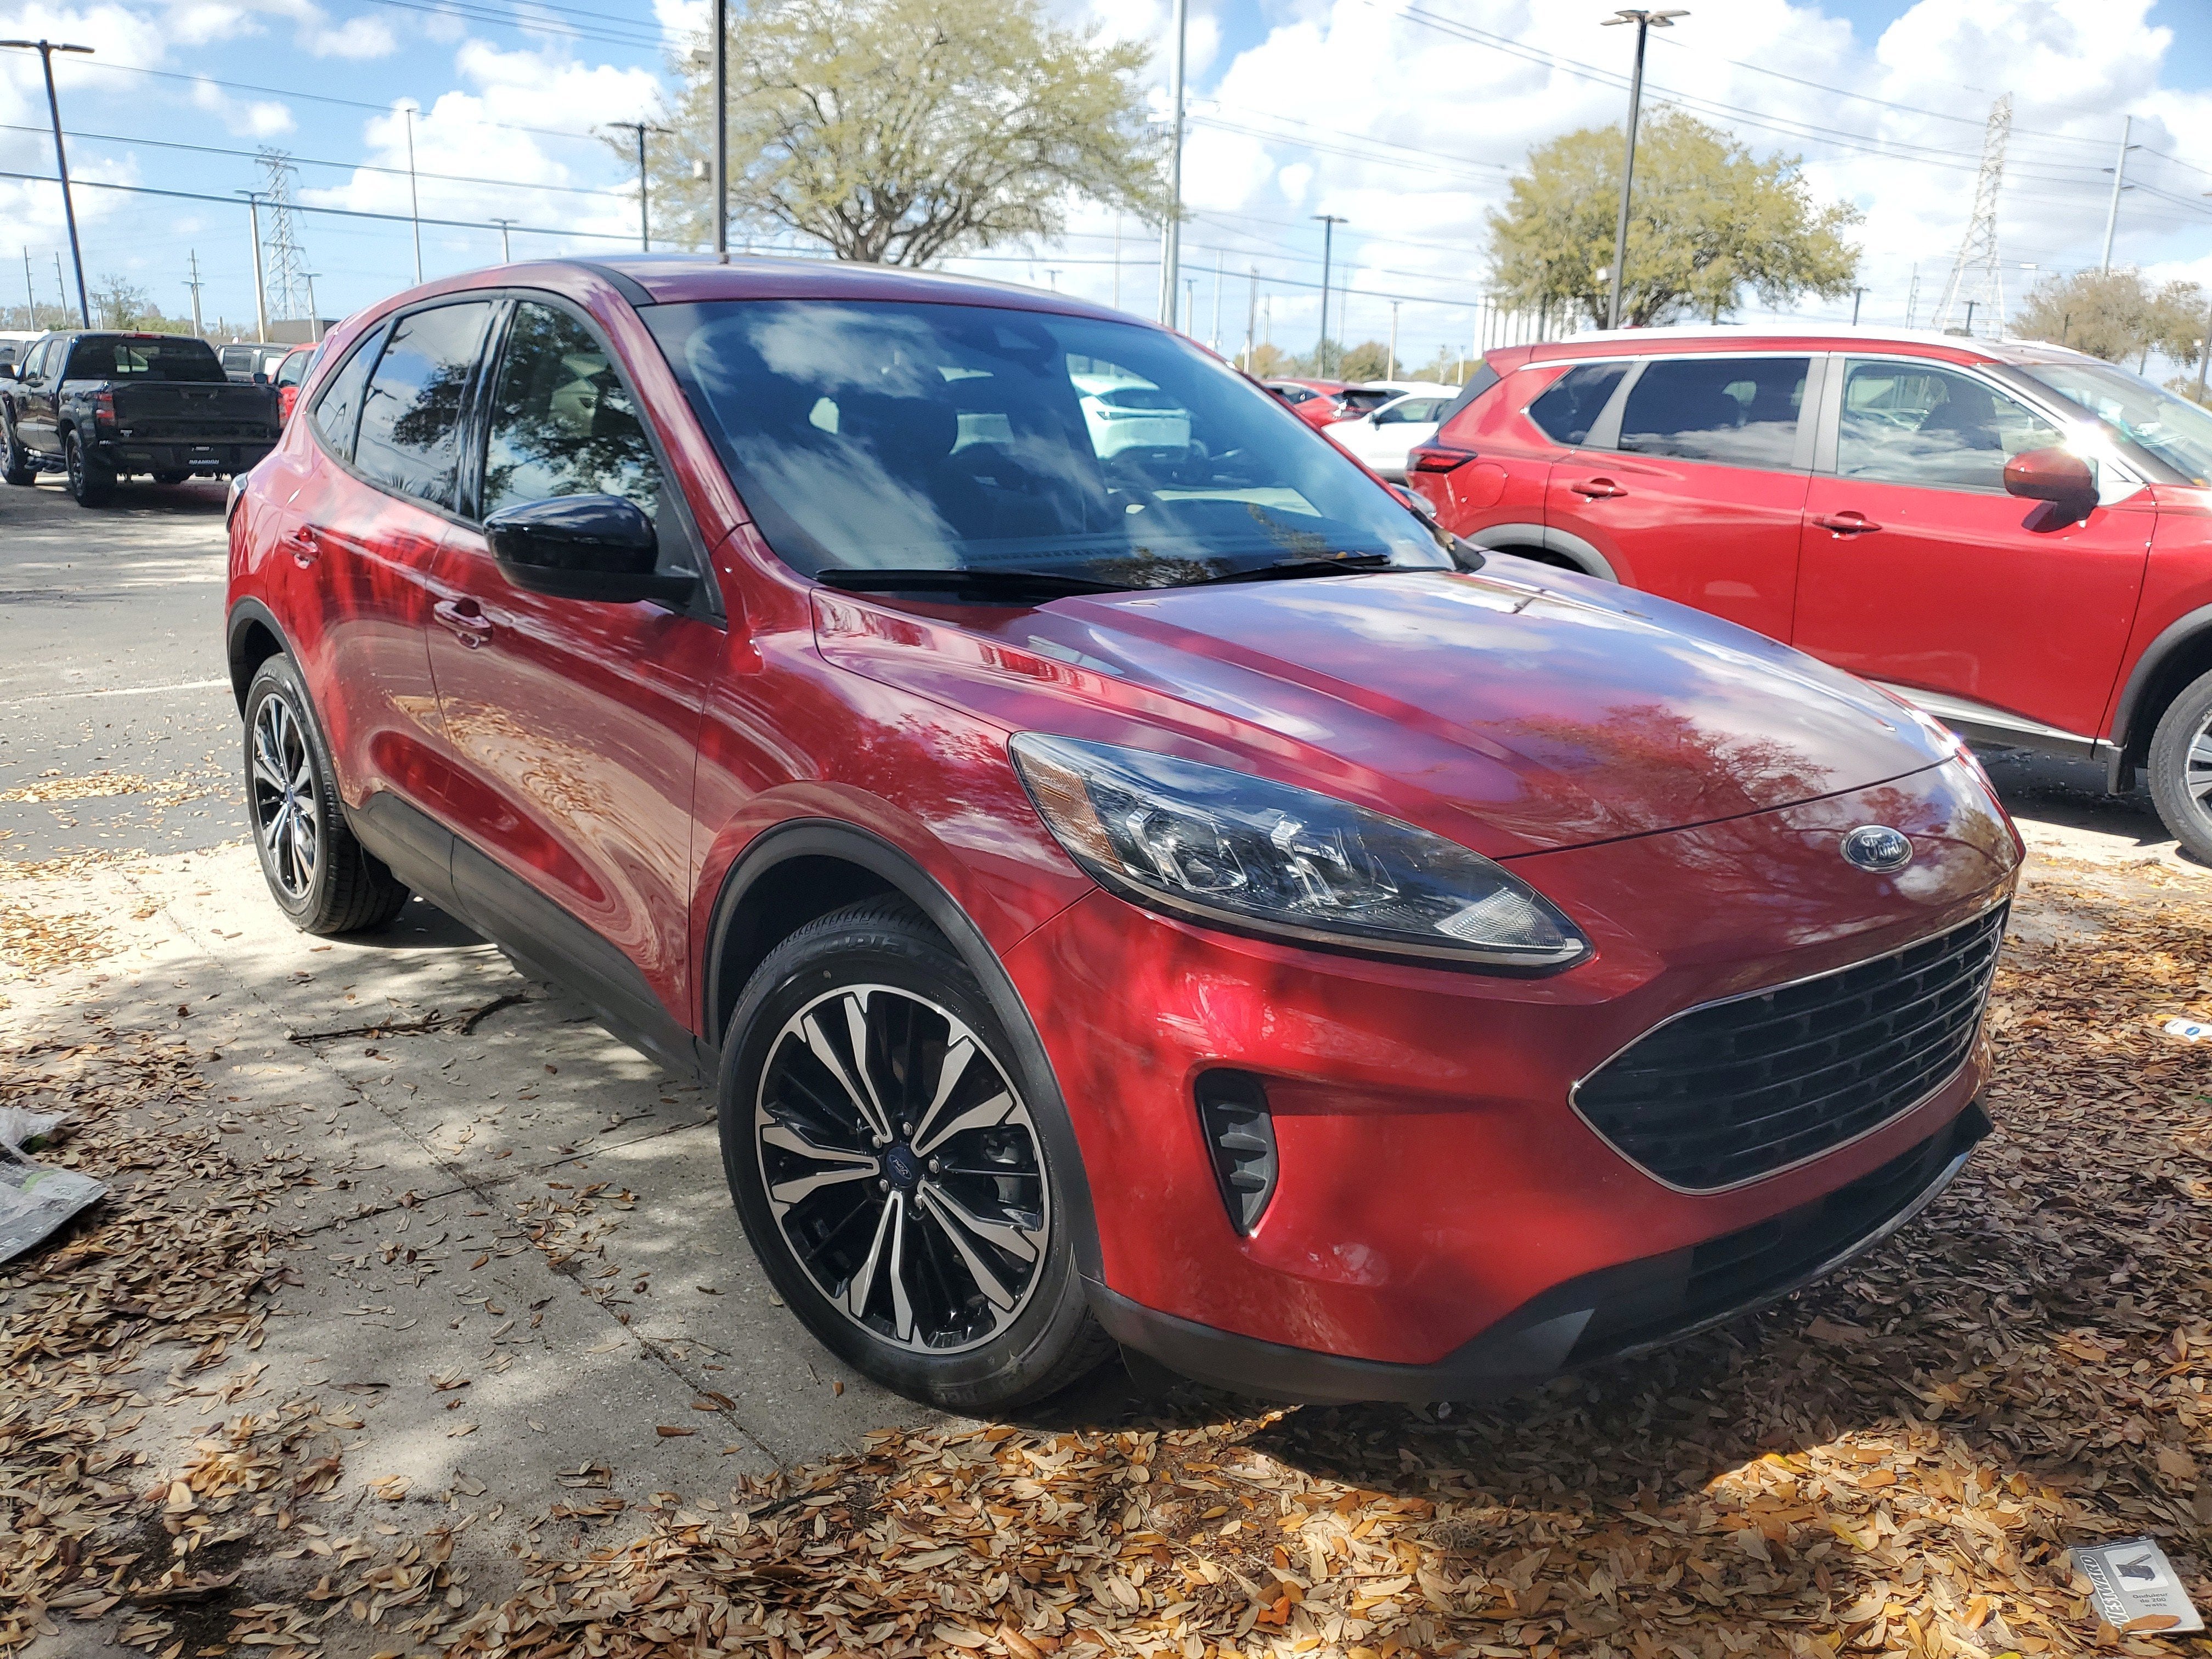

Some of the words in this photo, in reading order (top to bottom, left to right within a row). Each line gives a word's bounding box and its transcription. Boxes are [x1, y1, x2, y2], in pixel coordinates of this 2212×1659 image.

[1860, 832, 1903, 862] Ford
[893, 1158, 909, 1176] Ford
[2079, 1555, 2131, 1629] WESTWARD
